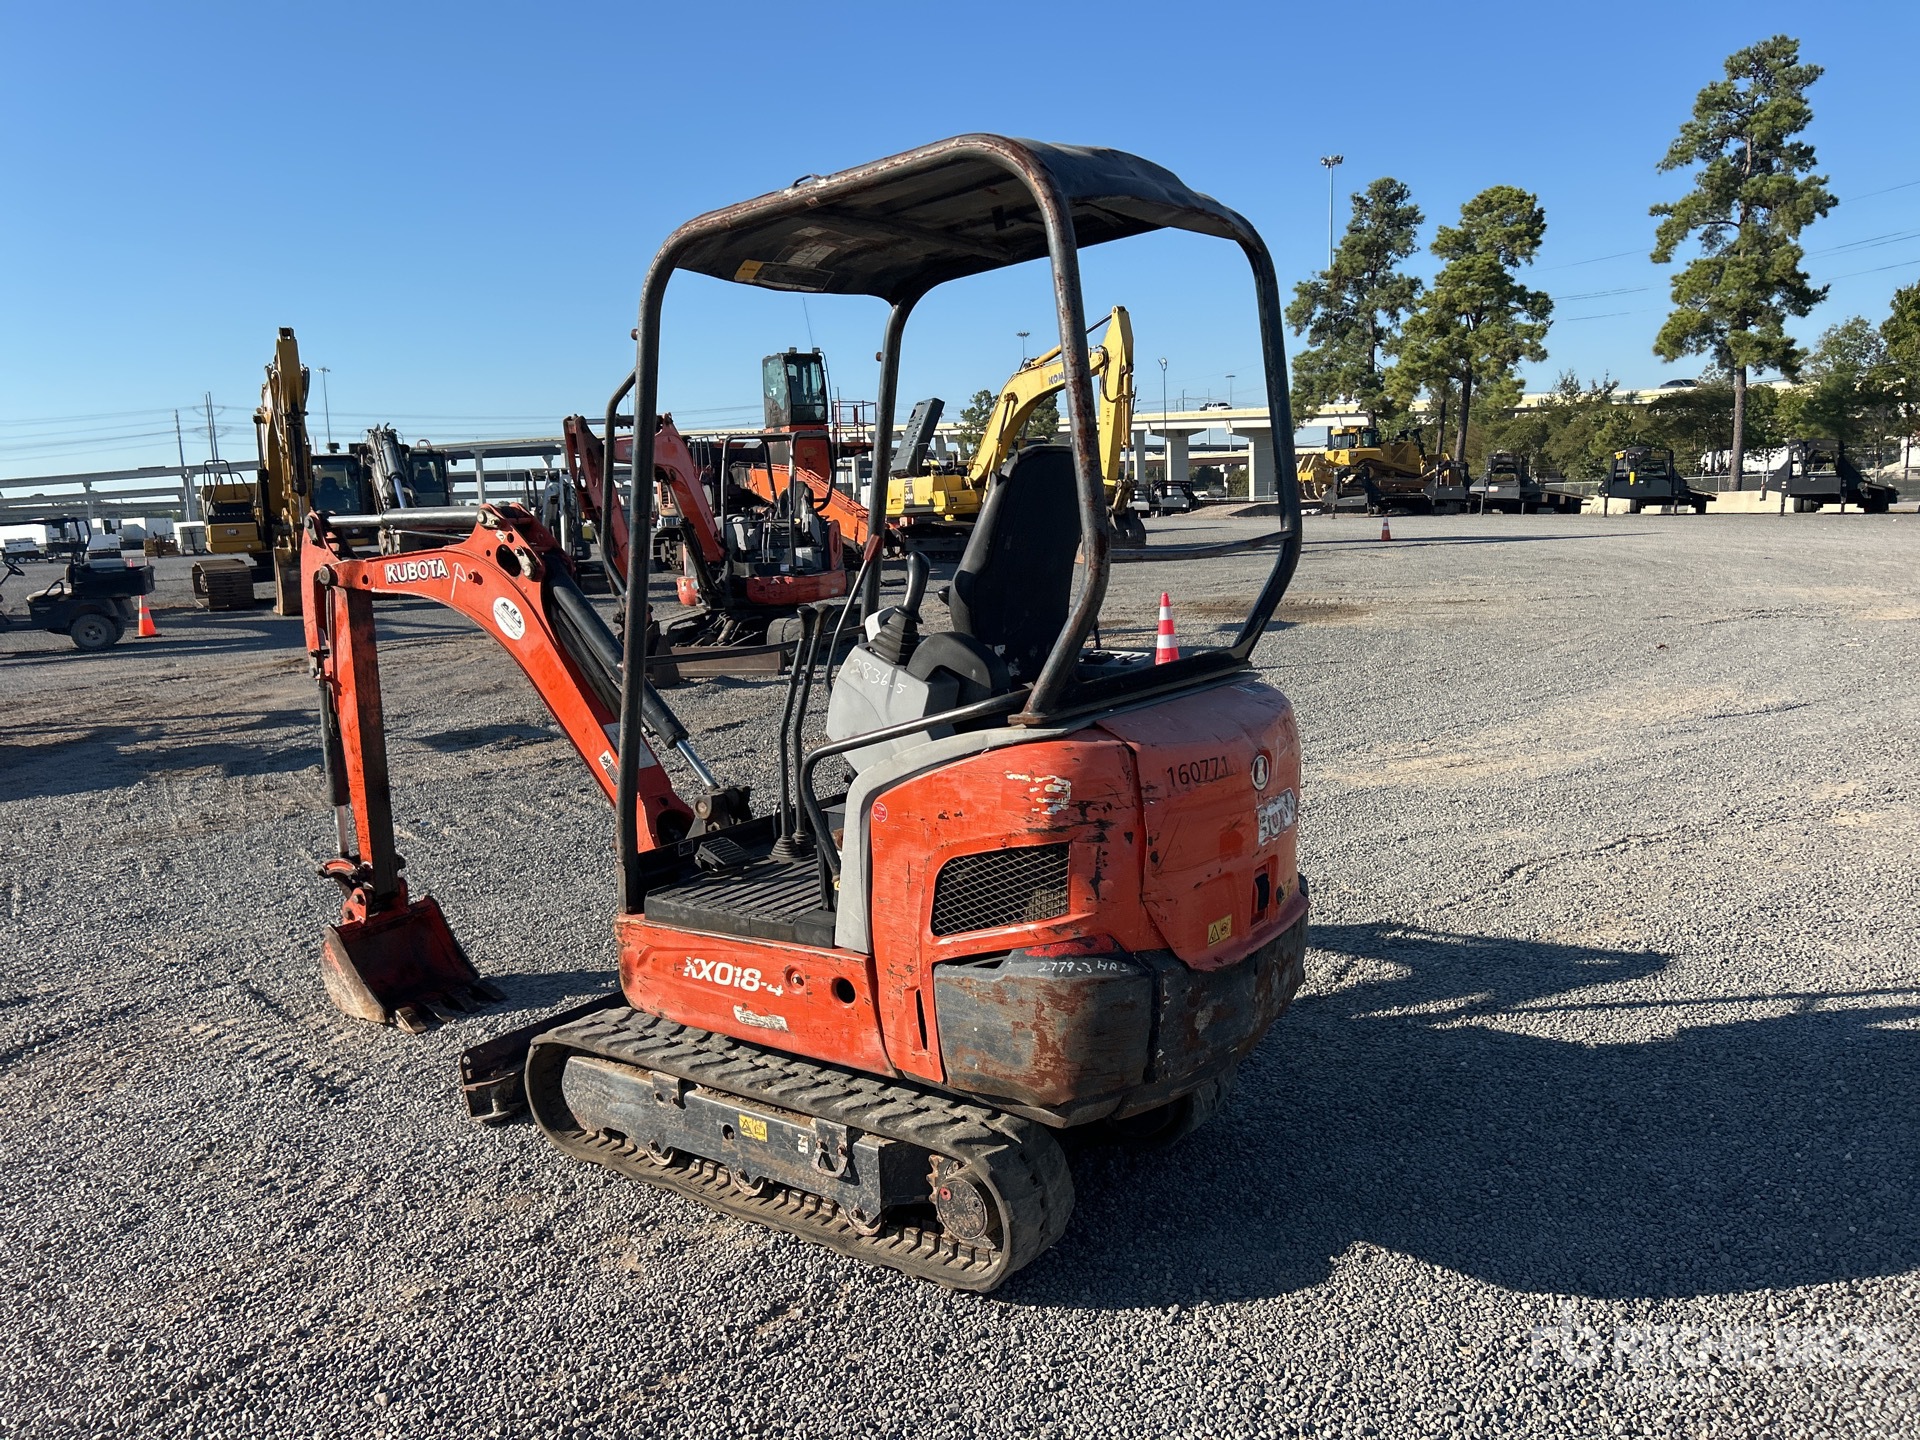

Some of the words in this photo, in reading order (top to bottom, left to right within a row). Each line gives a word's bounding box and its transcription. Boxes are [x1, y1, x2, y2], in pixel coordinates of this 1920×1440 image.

[1048, 371, 1065, 386] KOM
[385, 558, 449, 585] KUBOTA
[1166, 756, 1231, 787] 160771
